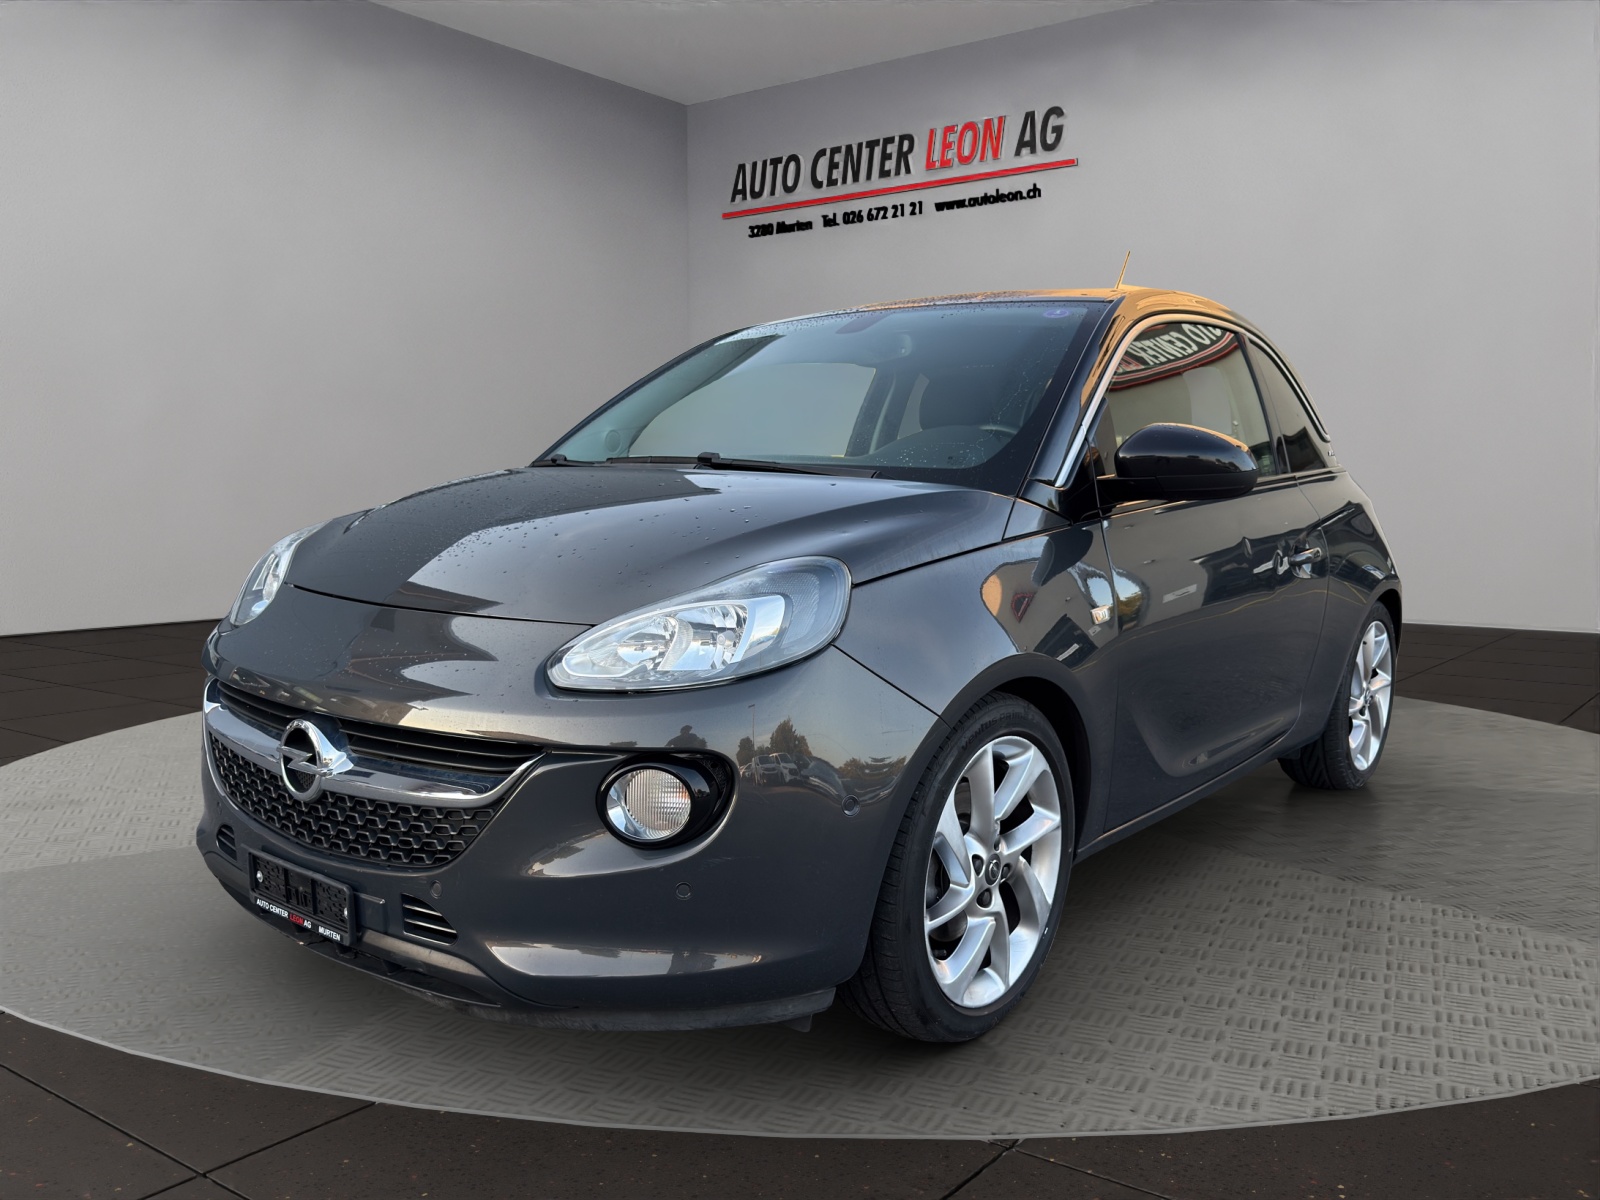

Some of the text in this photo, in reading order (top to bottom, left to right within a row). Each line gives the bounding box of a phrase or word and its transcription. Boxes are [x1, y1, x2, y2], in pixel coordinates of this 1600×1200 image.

[731, 106, 1065, 202] AUTO CENTER LEON AG
[822, 213, 840, 228] Tel.
[843, 210, 864, 225] 026
[867, 206, 889, 221] 672
[891, 204, 905, 218] 21
[909, 201, 923, 215] 21
[934, 184, 1041, 212] www.autoleon.ch
[256, 899, 341, 941] AUTO CENTER LEON AG MURTEN
